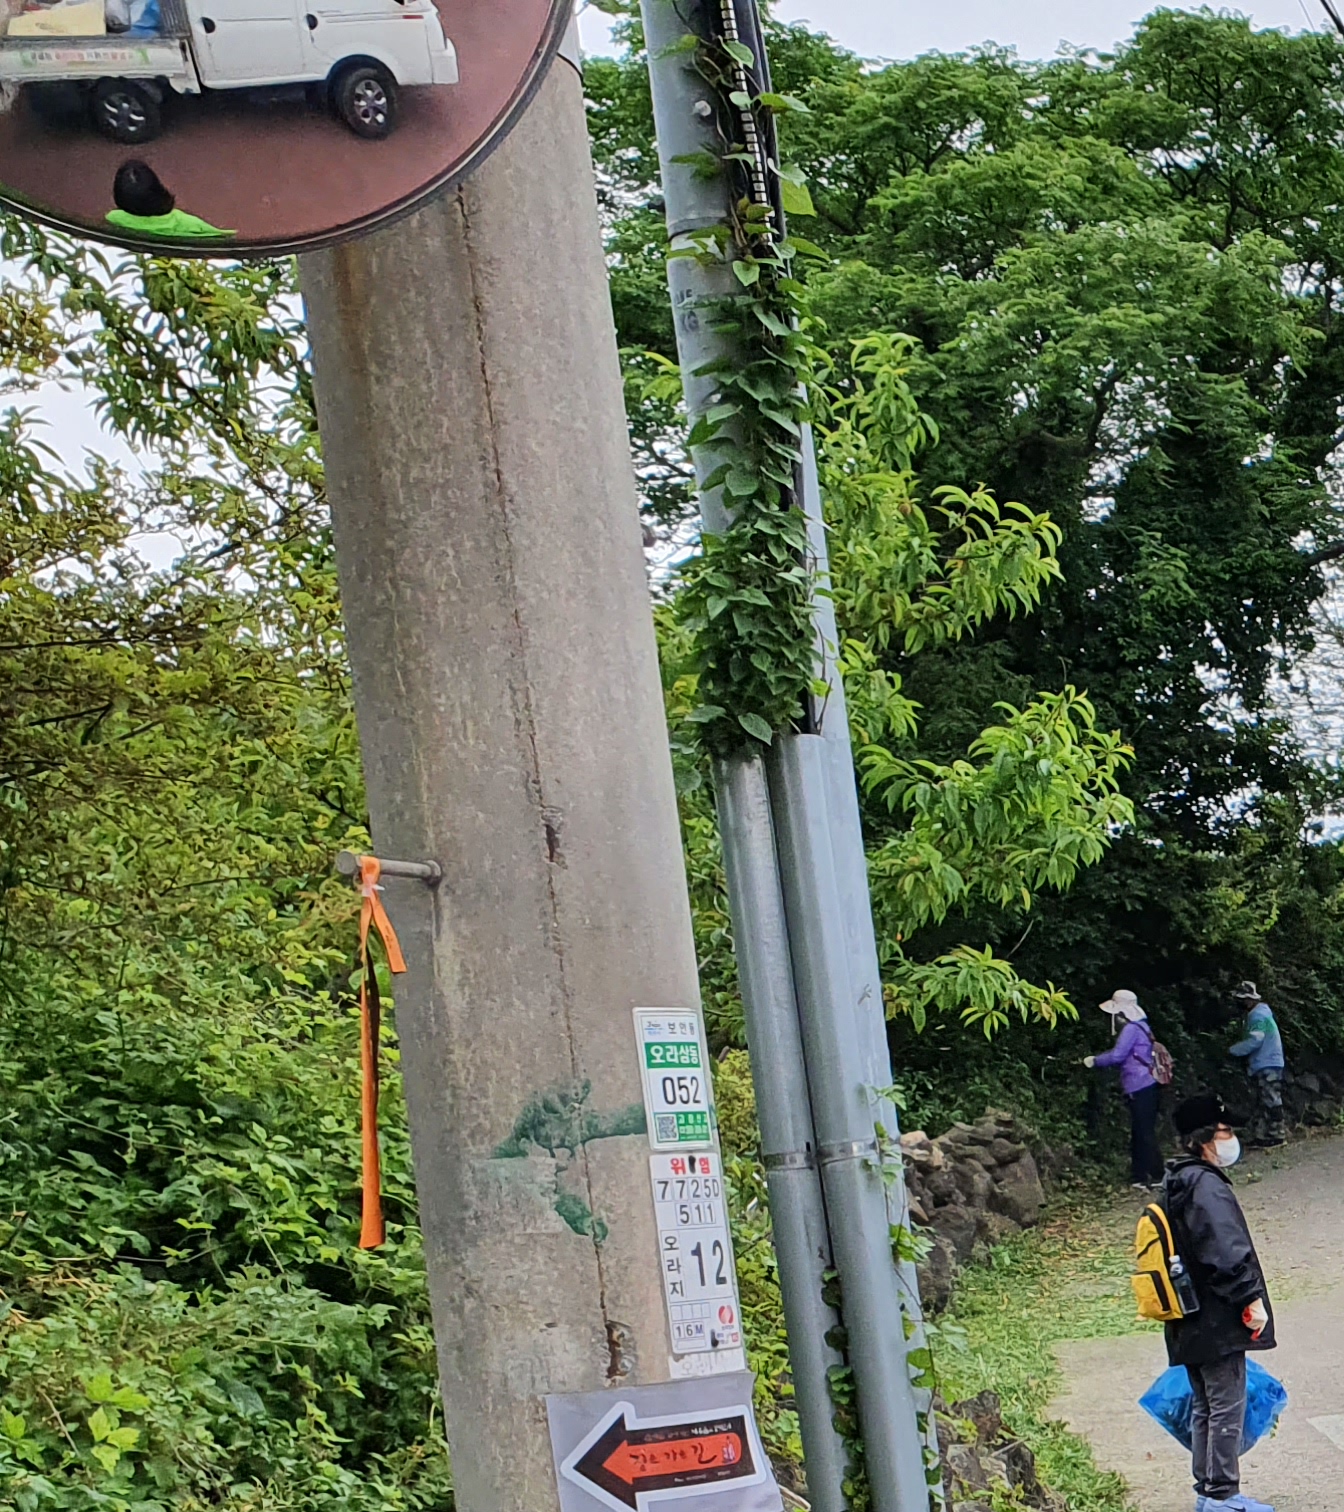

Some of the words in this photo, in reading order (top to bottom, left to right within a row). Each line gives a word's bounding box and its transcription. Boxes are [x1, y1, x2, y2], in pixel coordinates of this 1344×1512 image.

[650, 1045, 698, 1064] 오라삼동
[662, 1076, 701, 1105] 052
[680, 1204, 714, 1224] 511
[691, 1240, 728, 1287] 12
